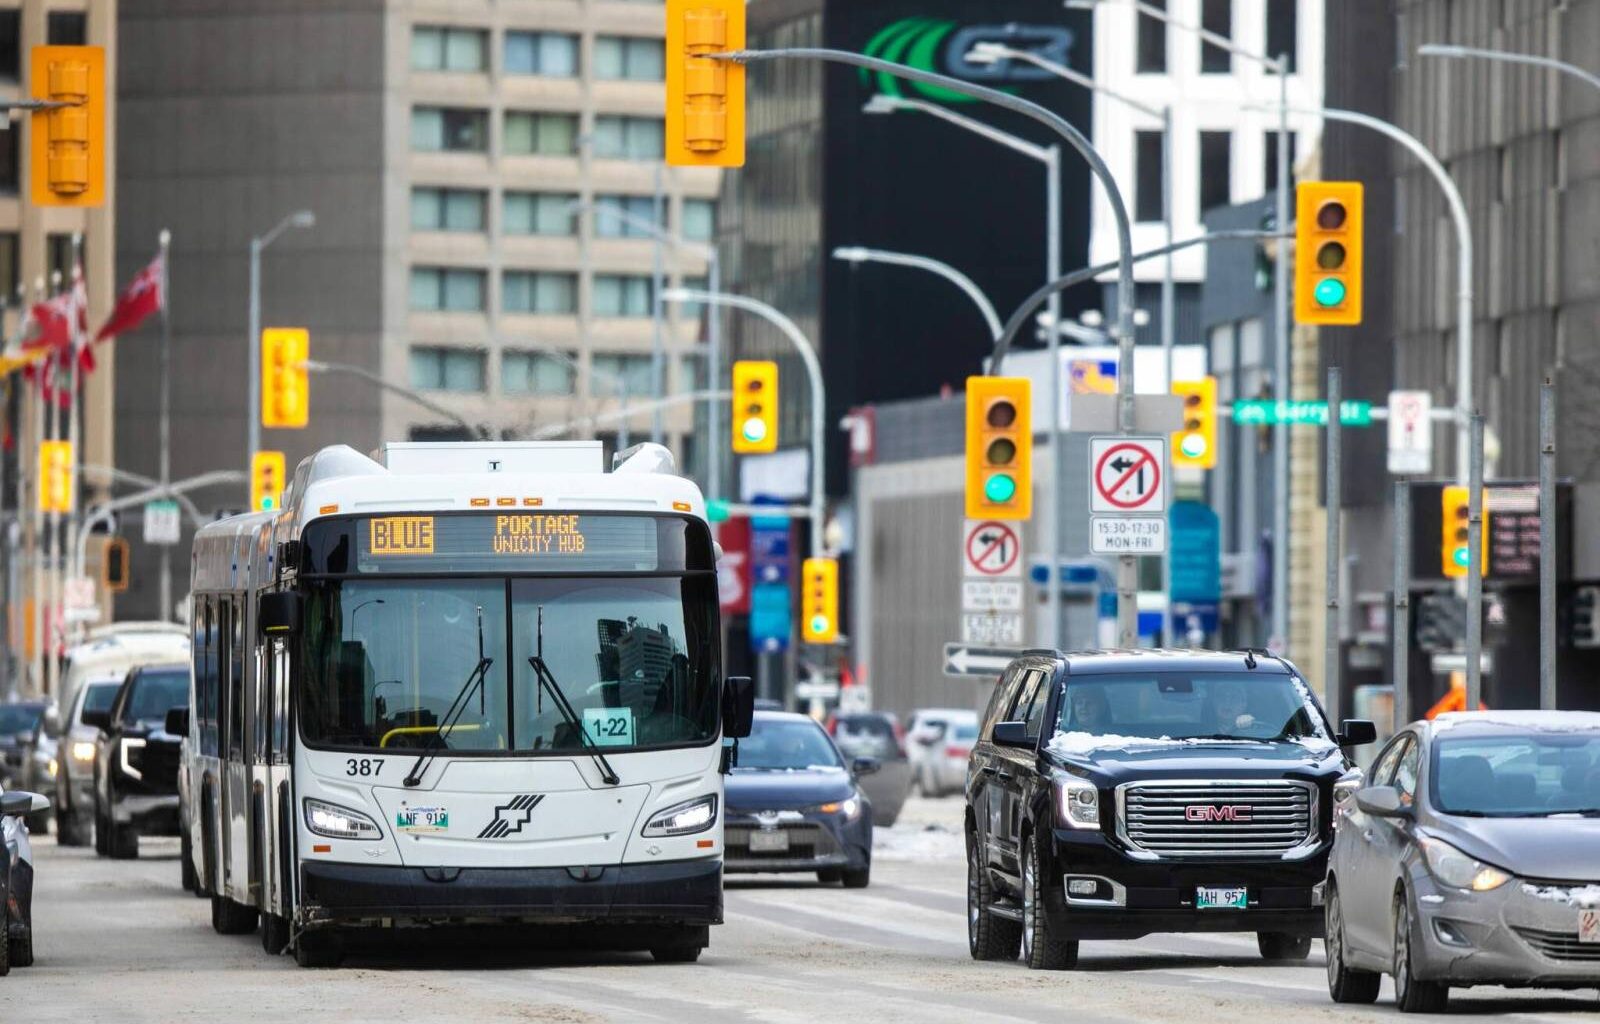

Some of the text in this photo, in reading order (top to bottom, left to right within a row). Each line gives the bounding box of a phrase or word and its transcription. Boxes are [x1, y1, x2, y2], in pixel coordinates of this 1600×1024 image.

[373, 515, 579, 549] BLUE PORTAGE
[494, 535, 585, 552] UNICITY HUB
[1105, 537, 1152, 547] MON-FRI
[593, 717, 628, 737] 1-22
[346, 759, 385, 776] 387
[399, 812, 446, 826] LNF 919
[1185, 805, 1252, 821] GMC
[1224, 891, 1245, 904] 957
